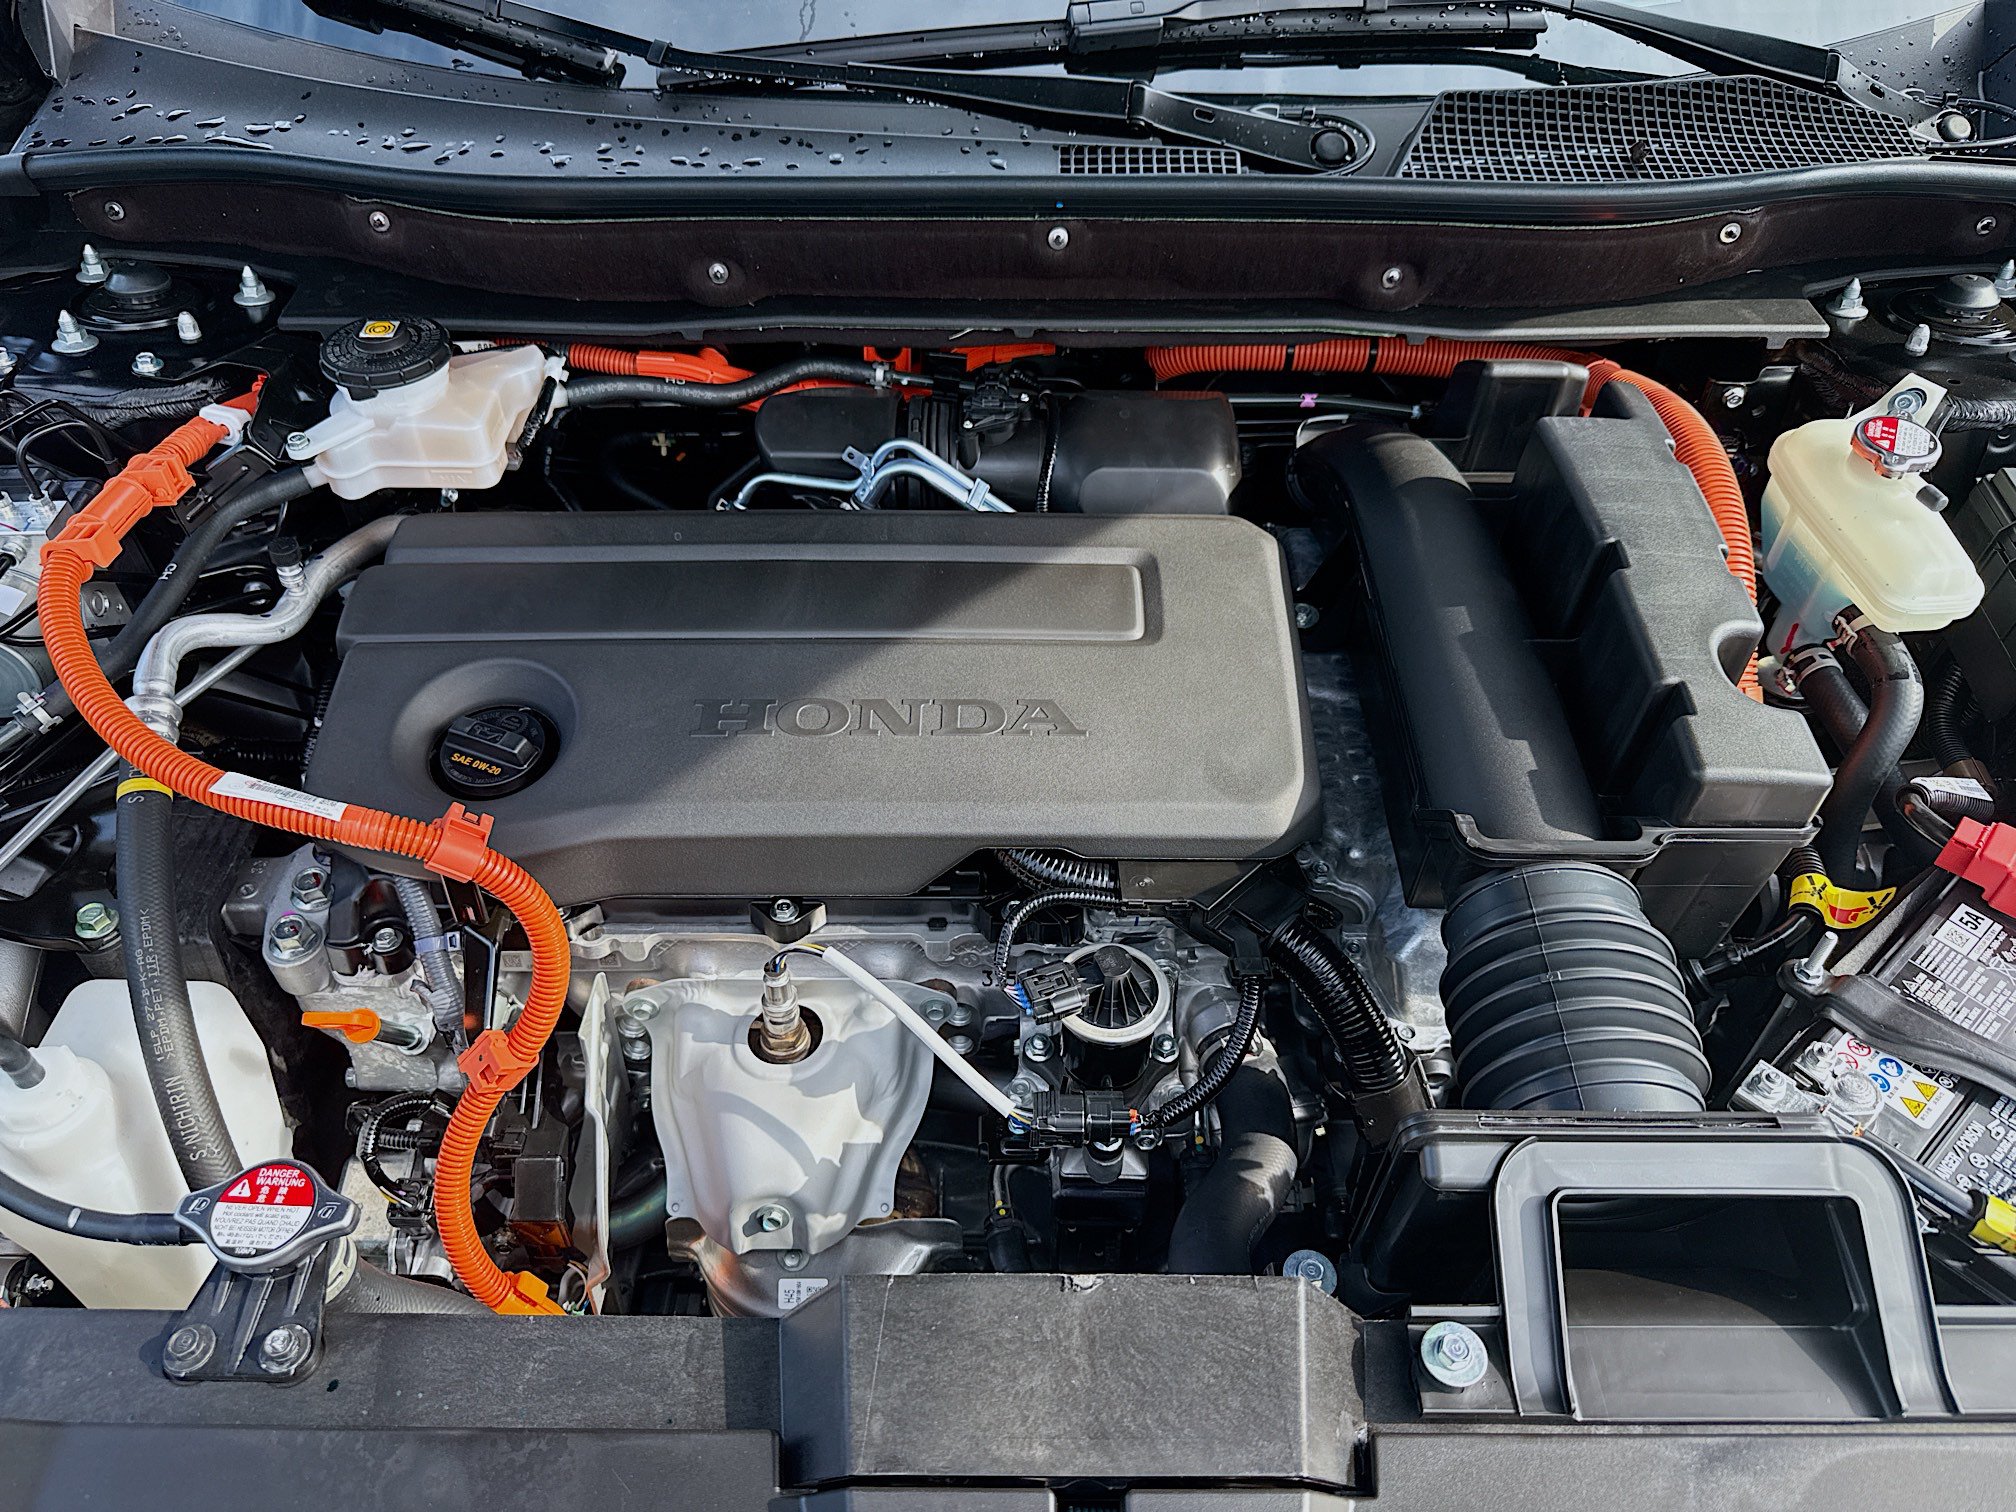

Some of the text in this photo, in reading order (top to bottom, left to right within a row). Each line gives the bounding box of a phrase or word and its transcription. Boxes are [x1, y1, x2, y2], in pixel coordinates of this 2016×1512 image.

[689, 699, 1089, 737] HONDA
[451, 752, 502, 776] SAE 0W-20
[1959, 911, 1985, 931] 5A
[259, 1168, 300, 1178] DANGER
[256, 1177, 306, 1187] WARNUNG
[784, 1289, 795, 1303] H45
